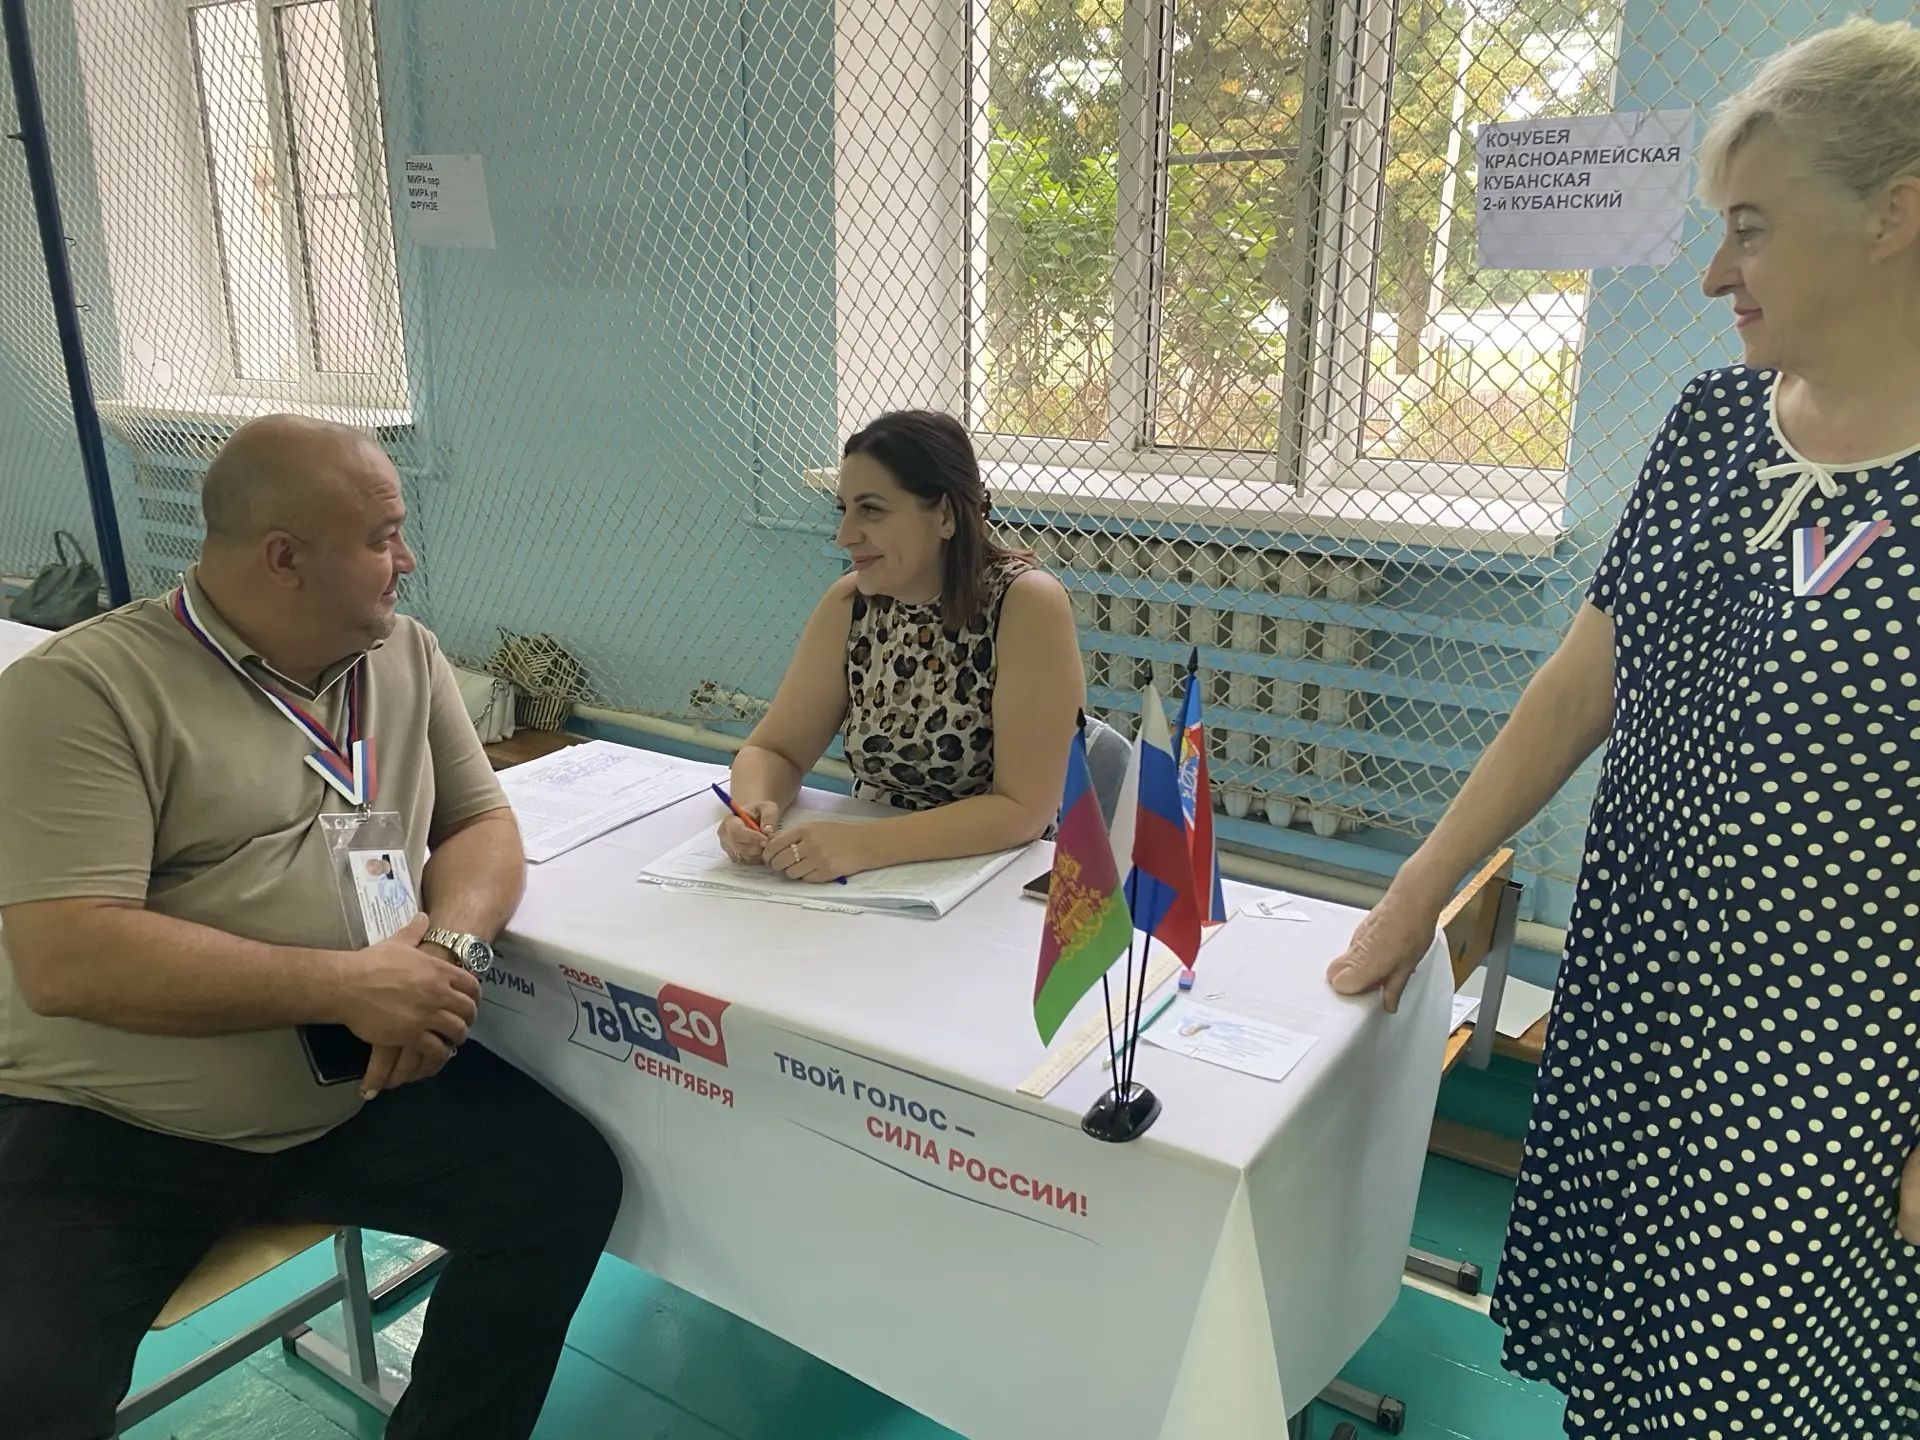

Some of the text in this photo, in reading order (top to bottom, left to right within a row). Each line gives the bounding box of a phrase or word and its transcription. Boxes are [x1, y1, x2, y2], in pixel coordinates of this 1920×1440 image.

[1486, 129, 1571, 148] КОЧУБЕЯ
[1485, 145, 1681, 169] КРАСНОАРМЕЙСКАЯ
[407, 175, 440, 187] МИРА пер
[1483, 172, 1591, 190] КУБАНСКАЯ
[409, 188, 438, 200] МИРА ул
[1483, 189, 1623, 211] 2-й КУБАНСКИЙ
[410, 201, 439, 211] ФРУНЗЕ
[559, 964, 604, 990] 2026
[581, 1000, 719, 1047] 18 19 20
[634, 1052, 735, 1108] СЕНТЯБРЯ
[774, 1051, 846, 1095] ТВОЙ
[853, 1080, 948, 1131] ГОЛОС
[866, 1116, 1088, 1217] СИЛА РОССИИ!
